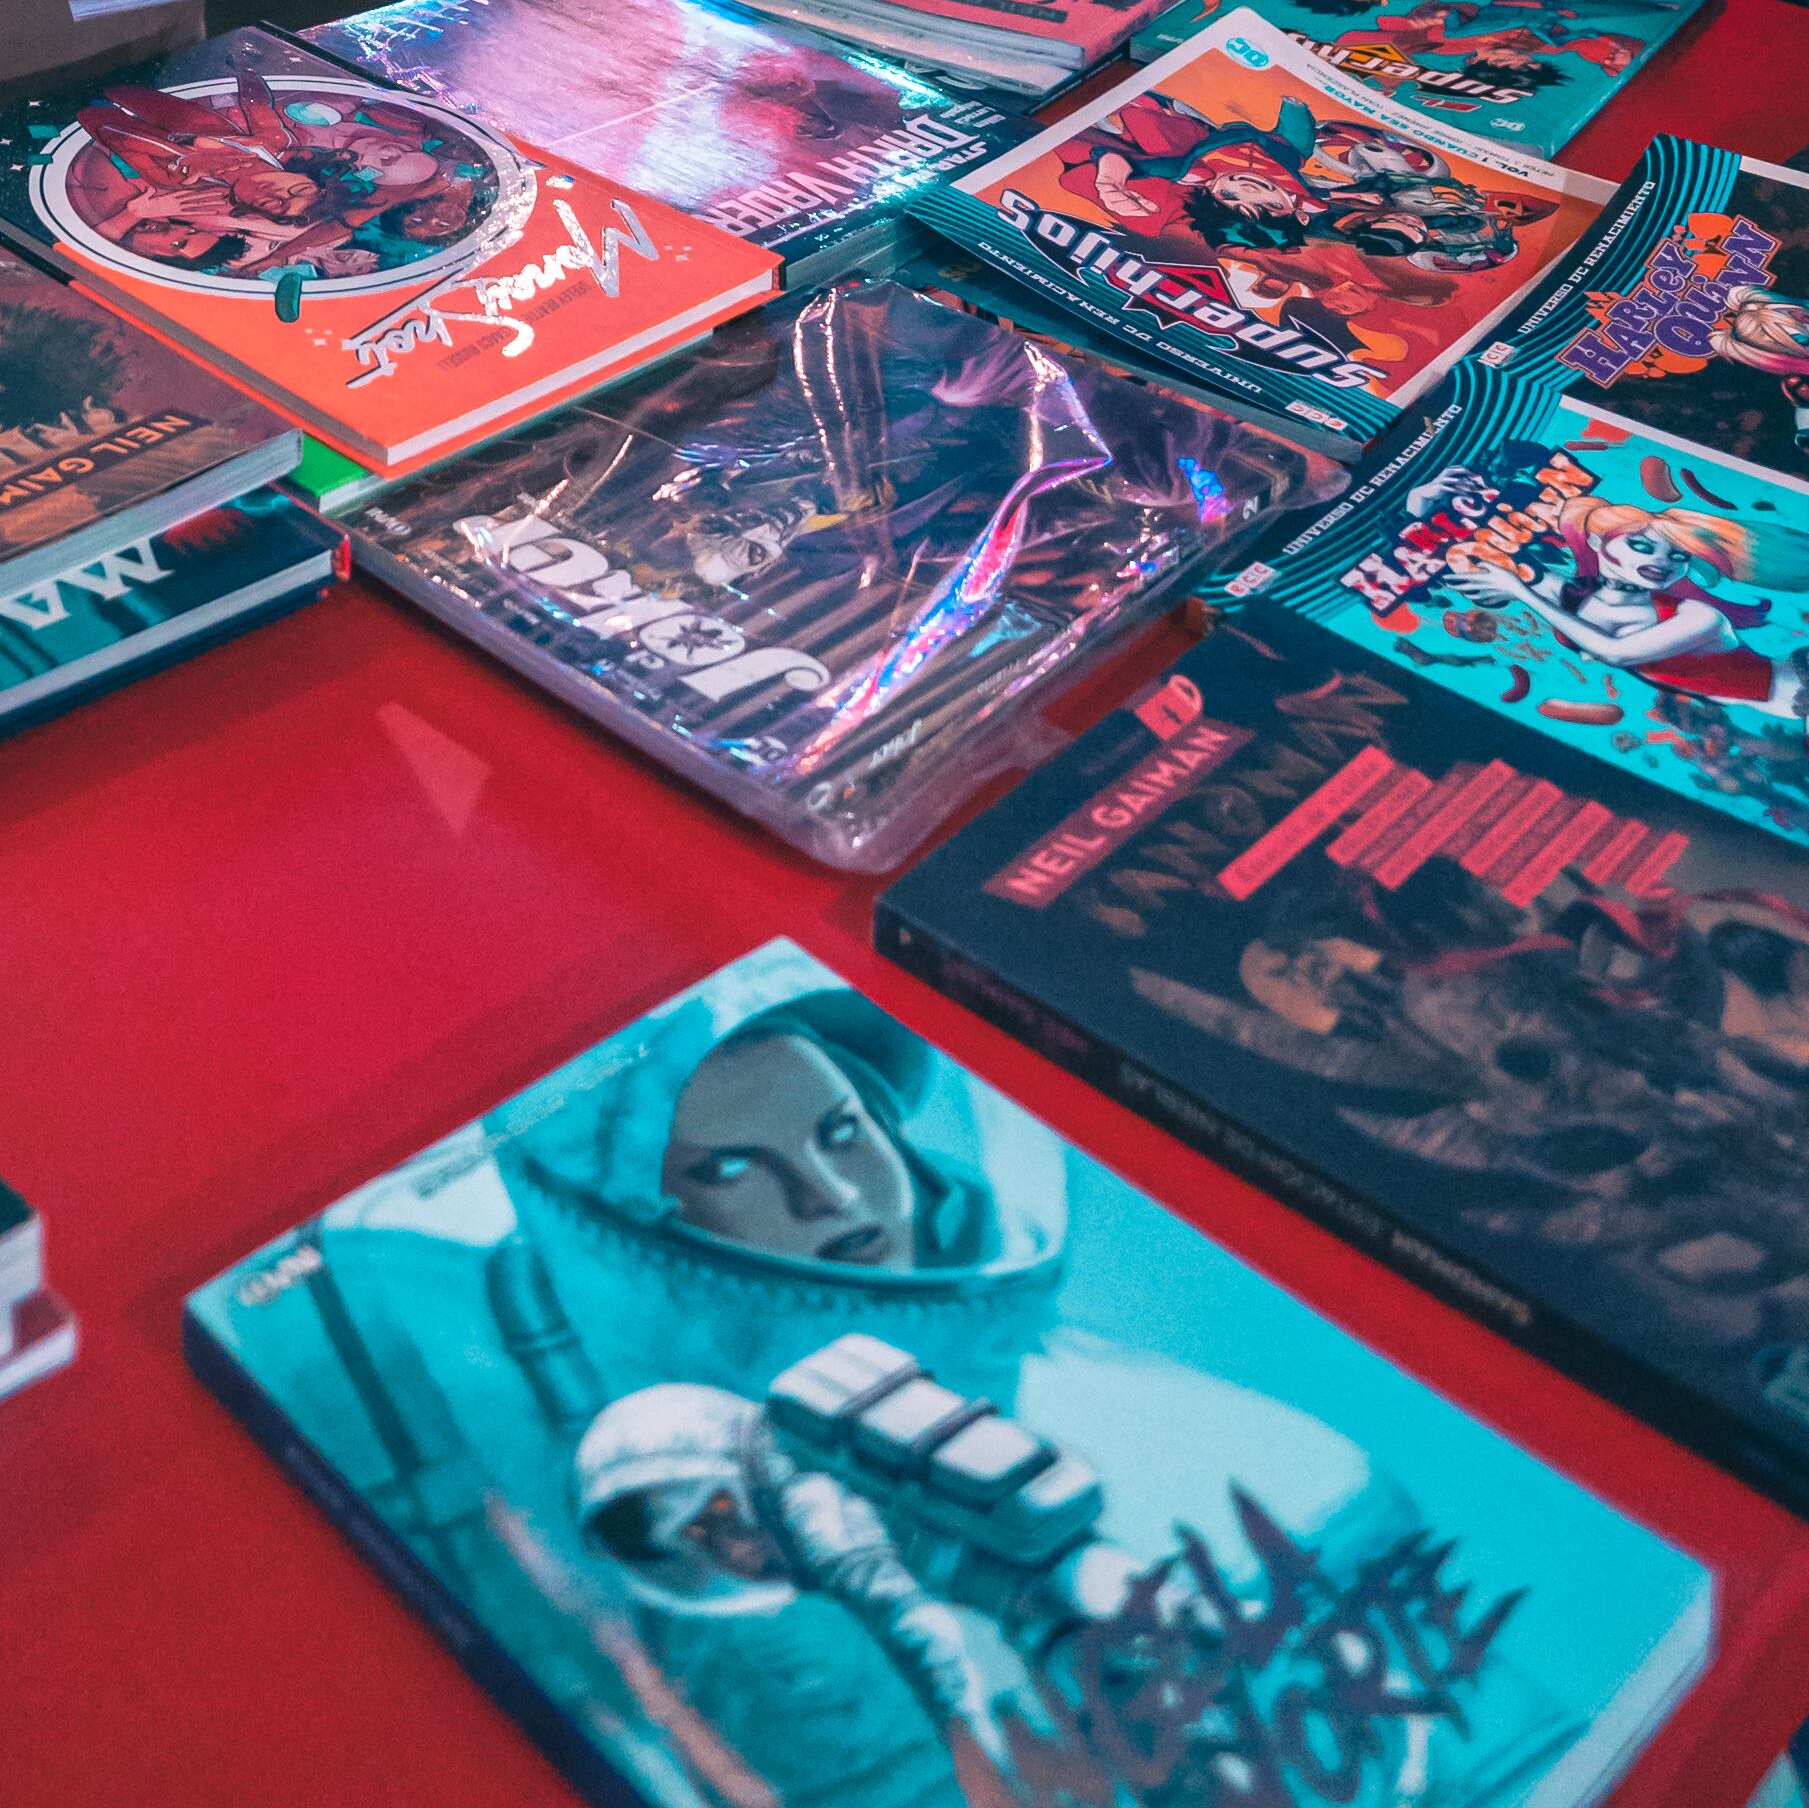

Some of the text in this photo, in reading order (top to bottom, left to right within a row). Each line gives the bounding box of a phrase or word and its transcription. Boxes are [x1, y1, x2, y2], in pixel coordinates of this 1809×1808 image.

[1228, 37, 1271, 69] DC
[816, 114, 980, 195] DARTH
[1494, 159, 1530, 179] VOL.
[695, 171, 842, 234] VADER
[977, 241, 1121, 326] RENACIMIENTO
[1518, 284, 1574, 336] UNIVERSO
[1570, 264, 1590, 285] DC
[1585, 179, 1657, 269] RENACIMIENTO
[1122, 323, 1153, 343] DC
[1154, 340, 1264, 395] UNIVERSO
[88, 412, 192, 457] NEIL
[1283, 501, 1355, 556] UNIVERSO
[1350, 485, 1373, 506] DC
[451, 513, 832, 703] Joker
[1008, 824, 1108, 897] NEIL
[1090, 723, 1233, 835] GAIMAN
